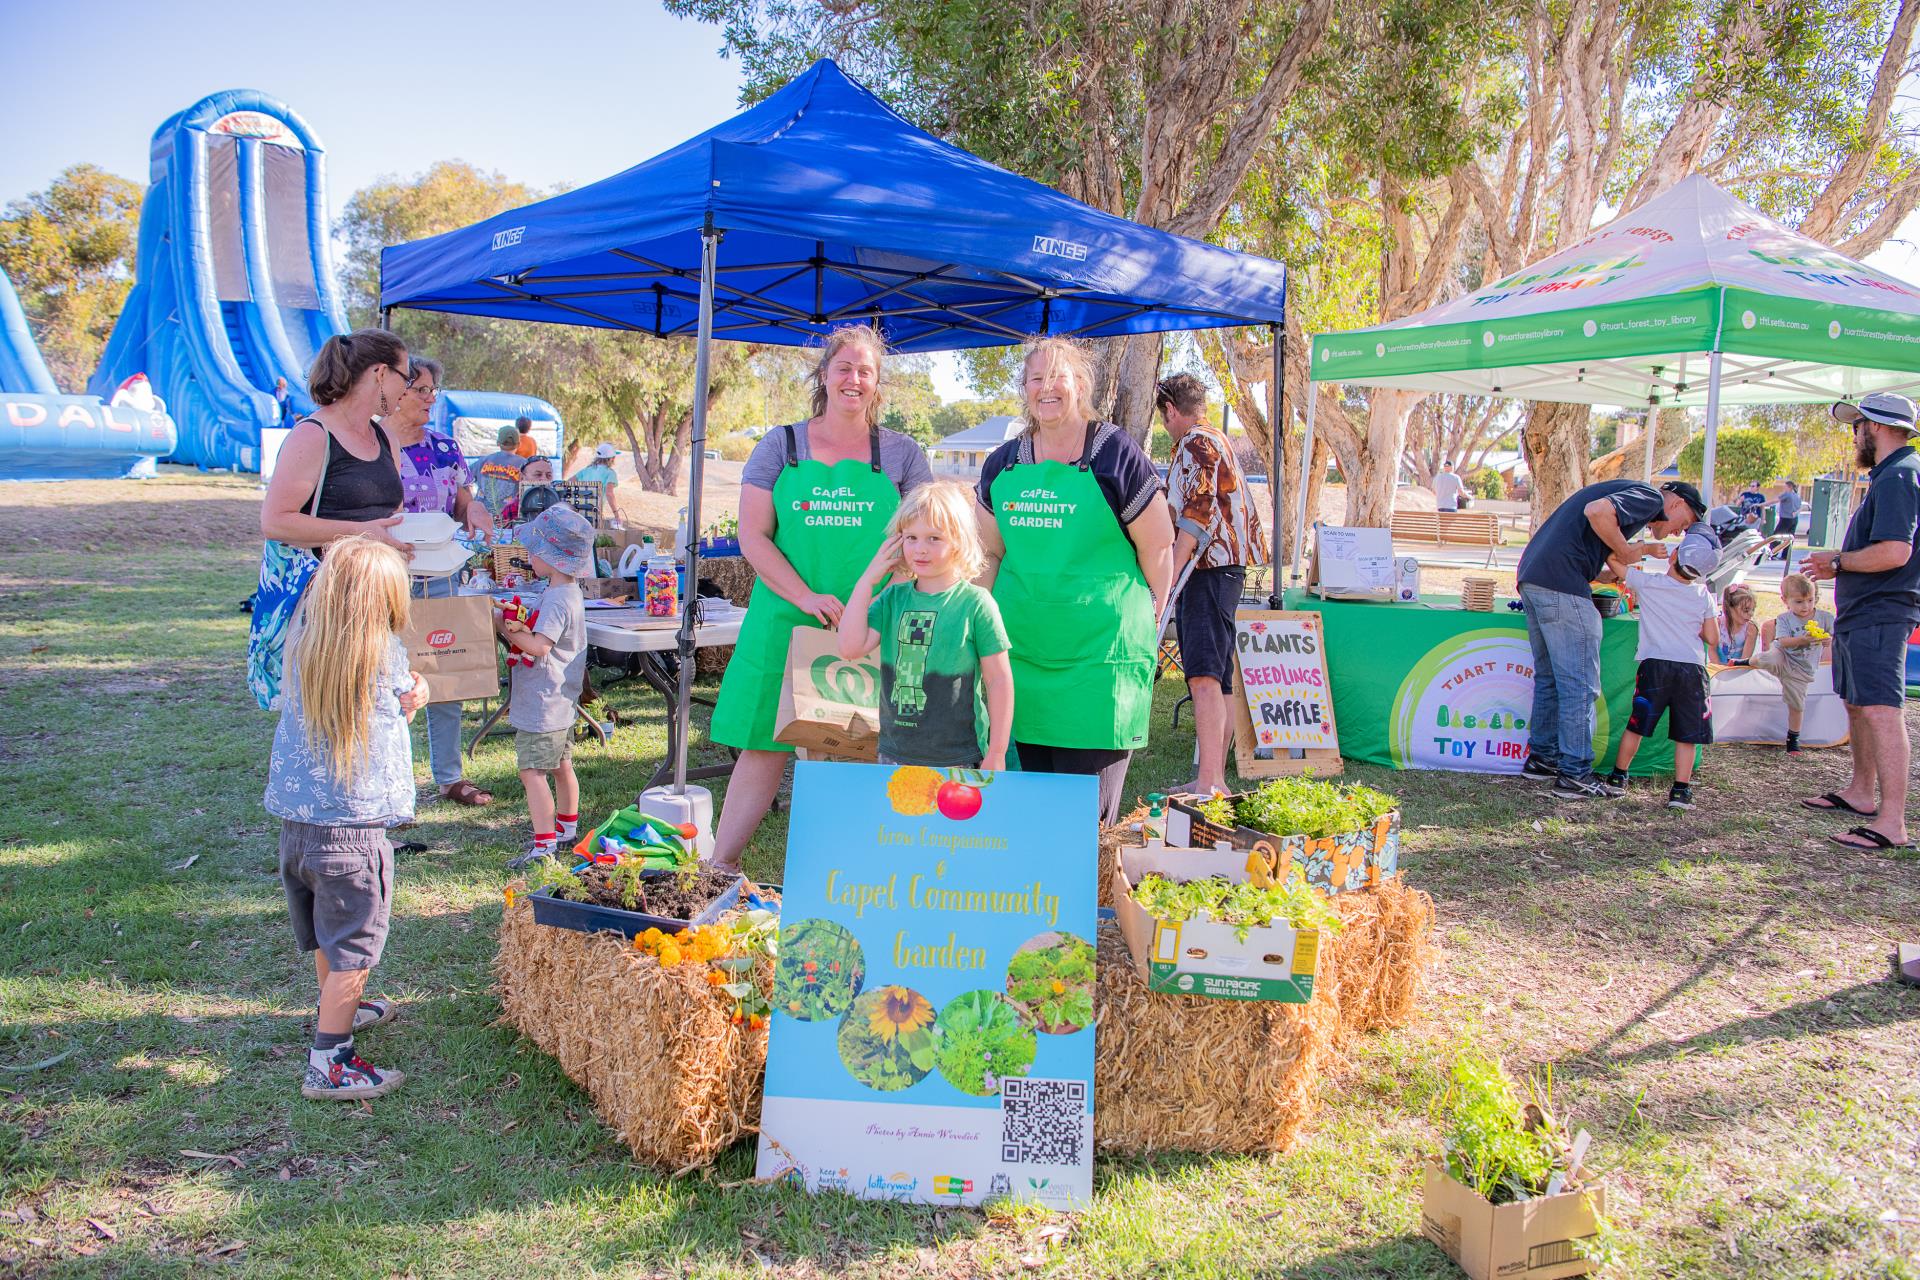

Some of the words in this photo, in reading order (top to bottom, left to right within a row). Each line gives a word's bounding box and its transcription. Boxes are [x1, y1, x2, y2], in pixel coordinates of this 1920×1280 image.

[492, 226, 526, 250] KINGS
[1033, 236, 1087, 261] KINGS
[1600, 315, 1697, 332] @tuart_forest_toy_library
[812, 486, 855, 499] CAPEL
[1020, 488, 1058, 499] CAPEL
[804, 515, 862, 527] GARDEN
[1009, 515, 1063, 528] GARDEN
[430, 632, 452, 644] IGA
[1237, 632, 1316, 654] PLANTS
[1244, 664, 1322, 686] SEEDLINGS
[1441, 661, 1497, 691] TUART
[1260, 700, 1321, 726] RAFFLE
[1434, 737, 1477, 759] TOY
[878, 824, 913, 846] Grow
[919, 826, 1008, 855] Companions
[826, 868, 898, 918] Capel
[908, 873, 1060, 927] Community
[893, 929, 986, 970] Garden
[865, 1123, 894, 1136] Photos
[896, 1128, 905, 1141] by
[819, 1167, 836, 1176] Keep
[867, 1173, 918, 1193] lotterywest
